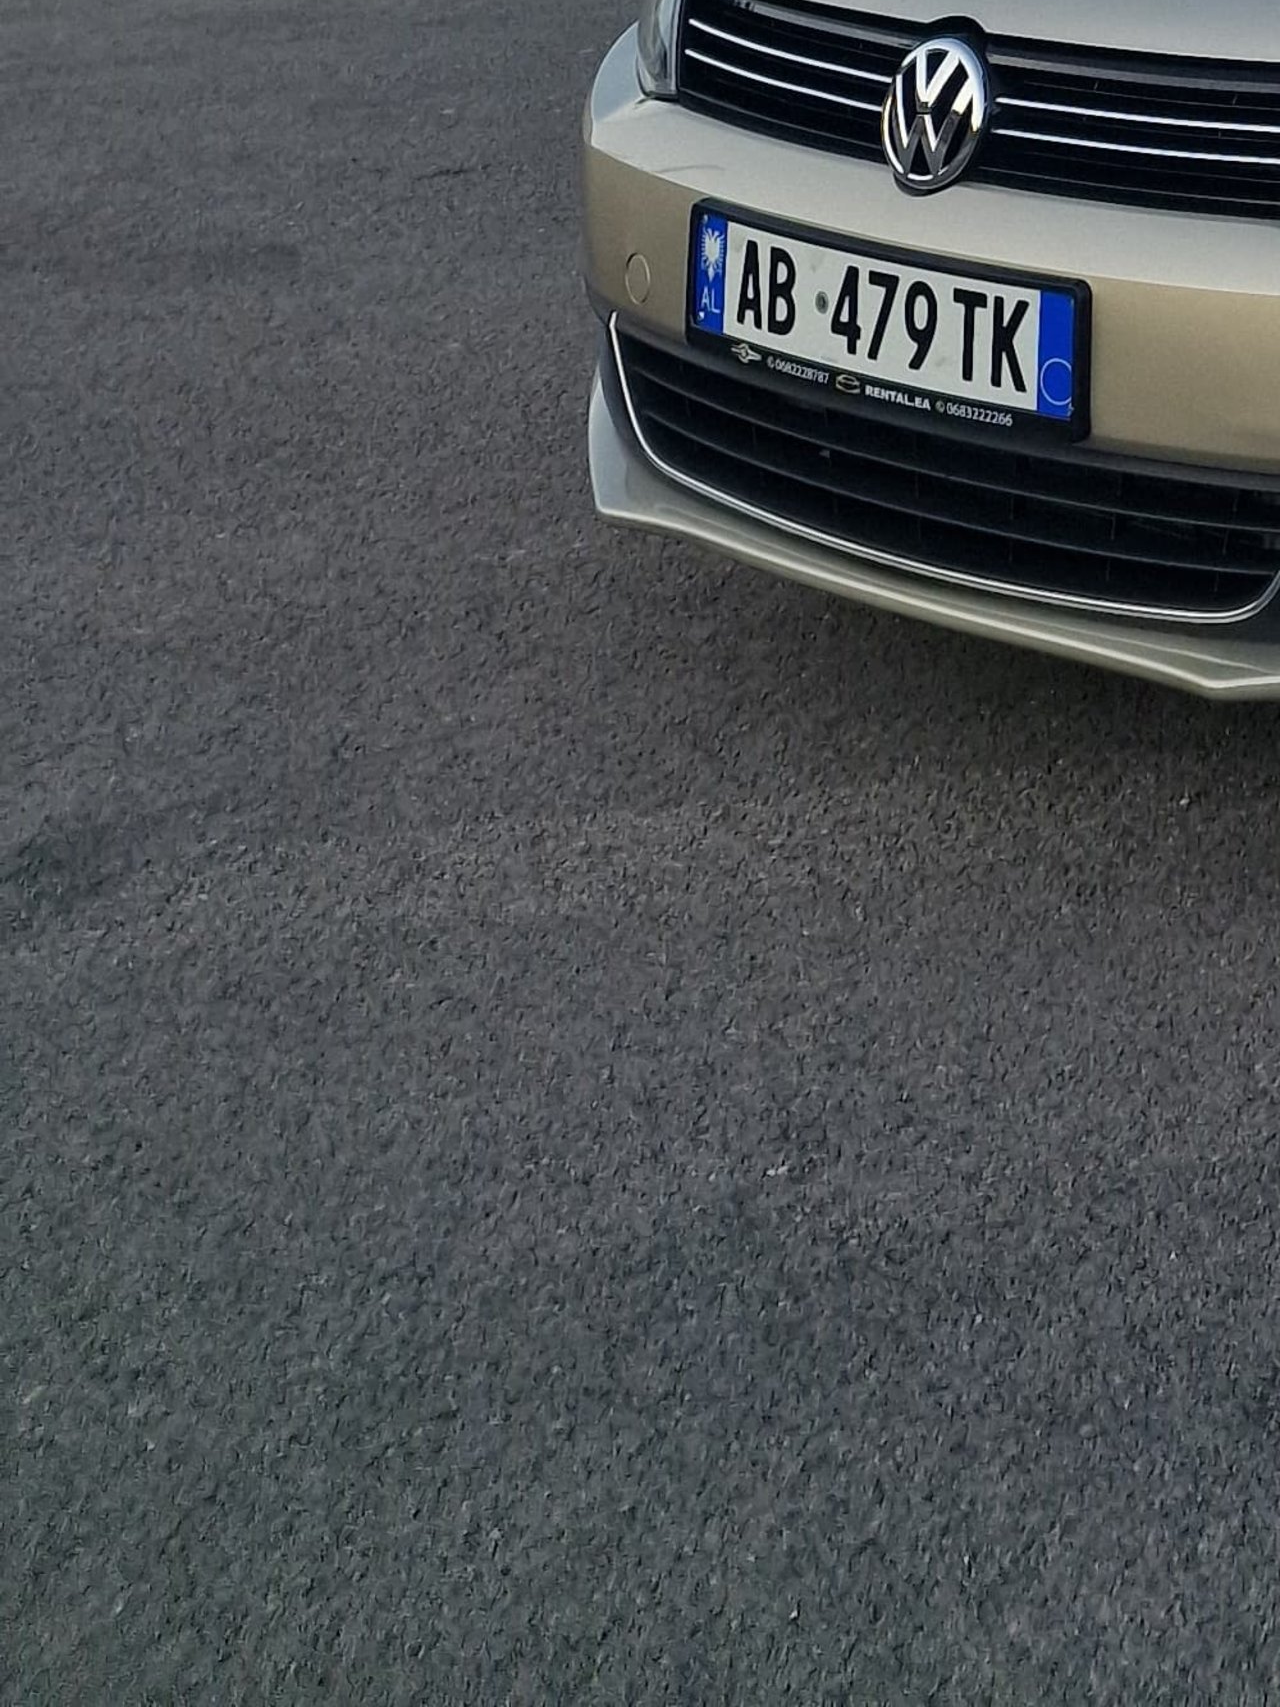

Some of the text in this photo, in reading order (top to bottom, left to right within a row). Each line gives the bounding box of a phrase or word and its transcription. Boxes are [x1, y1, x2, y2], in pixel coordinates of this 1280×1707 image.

[882, 38, 985, 188] VW
[701, 286, 721, 313] AL
[736, 239, 1030, 393] AB 479 TK
[946, 402, 1013, 427] 0683222266
